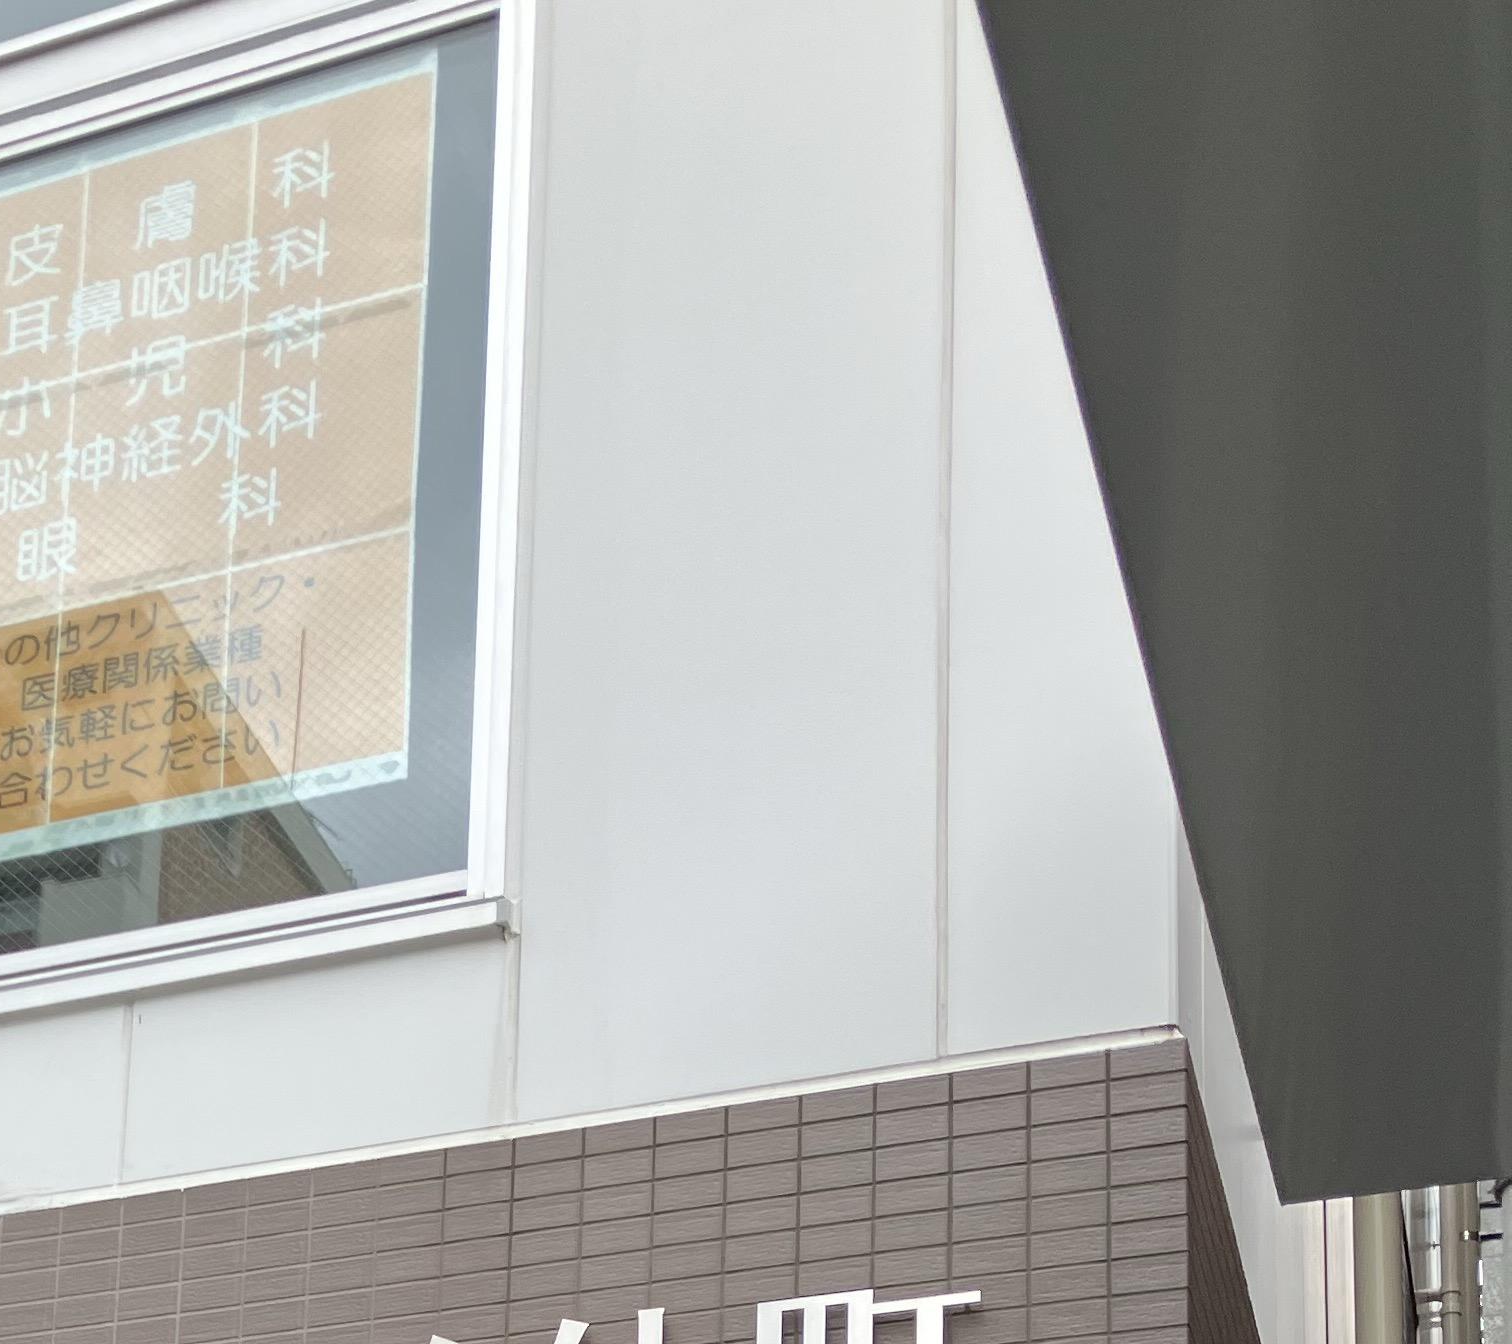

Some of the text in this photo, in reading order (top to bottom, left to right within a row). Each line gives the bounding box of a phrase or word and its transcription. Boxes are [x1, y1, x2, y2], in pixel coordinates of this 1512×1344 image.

[0, 218, 329, 356] 耳鼻咽喉科
[21, 624, 264, 711] 医療関係業種
[0, 670, 282, 762] お気軽にお問い
